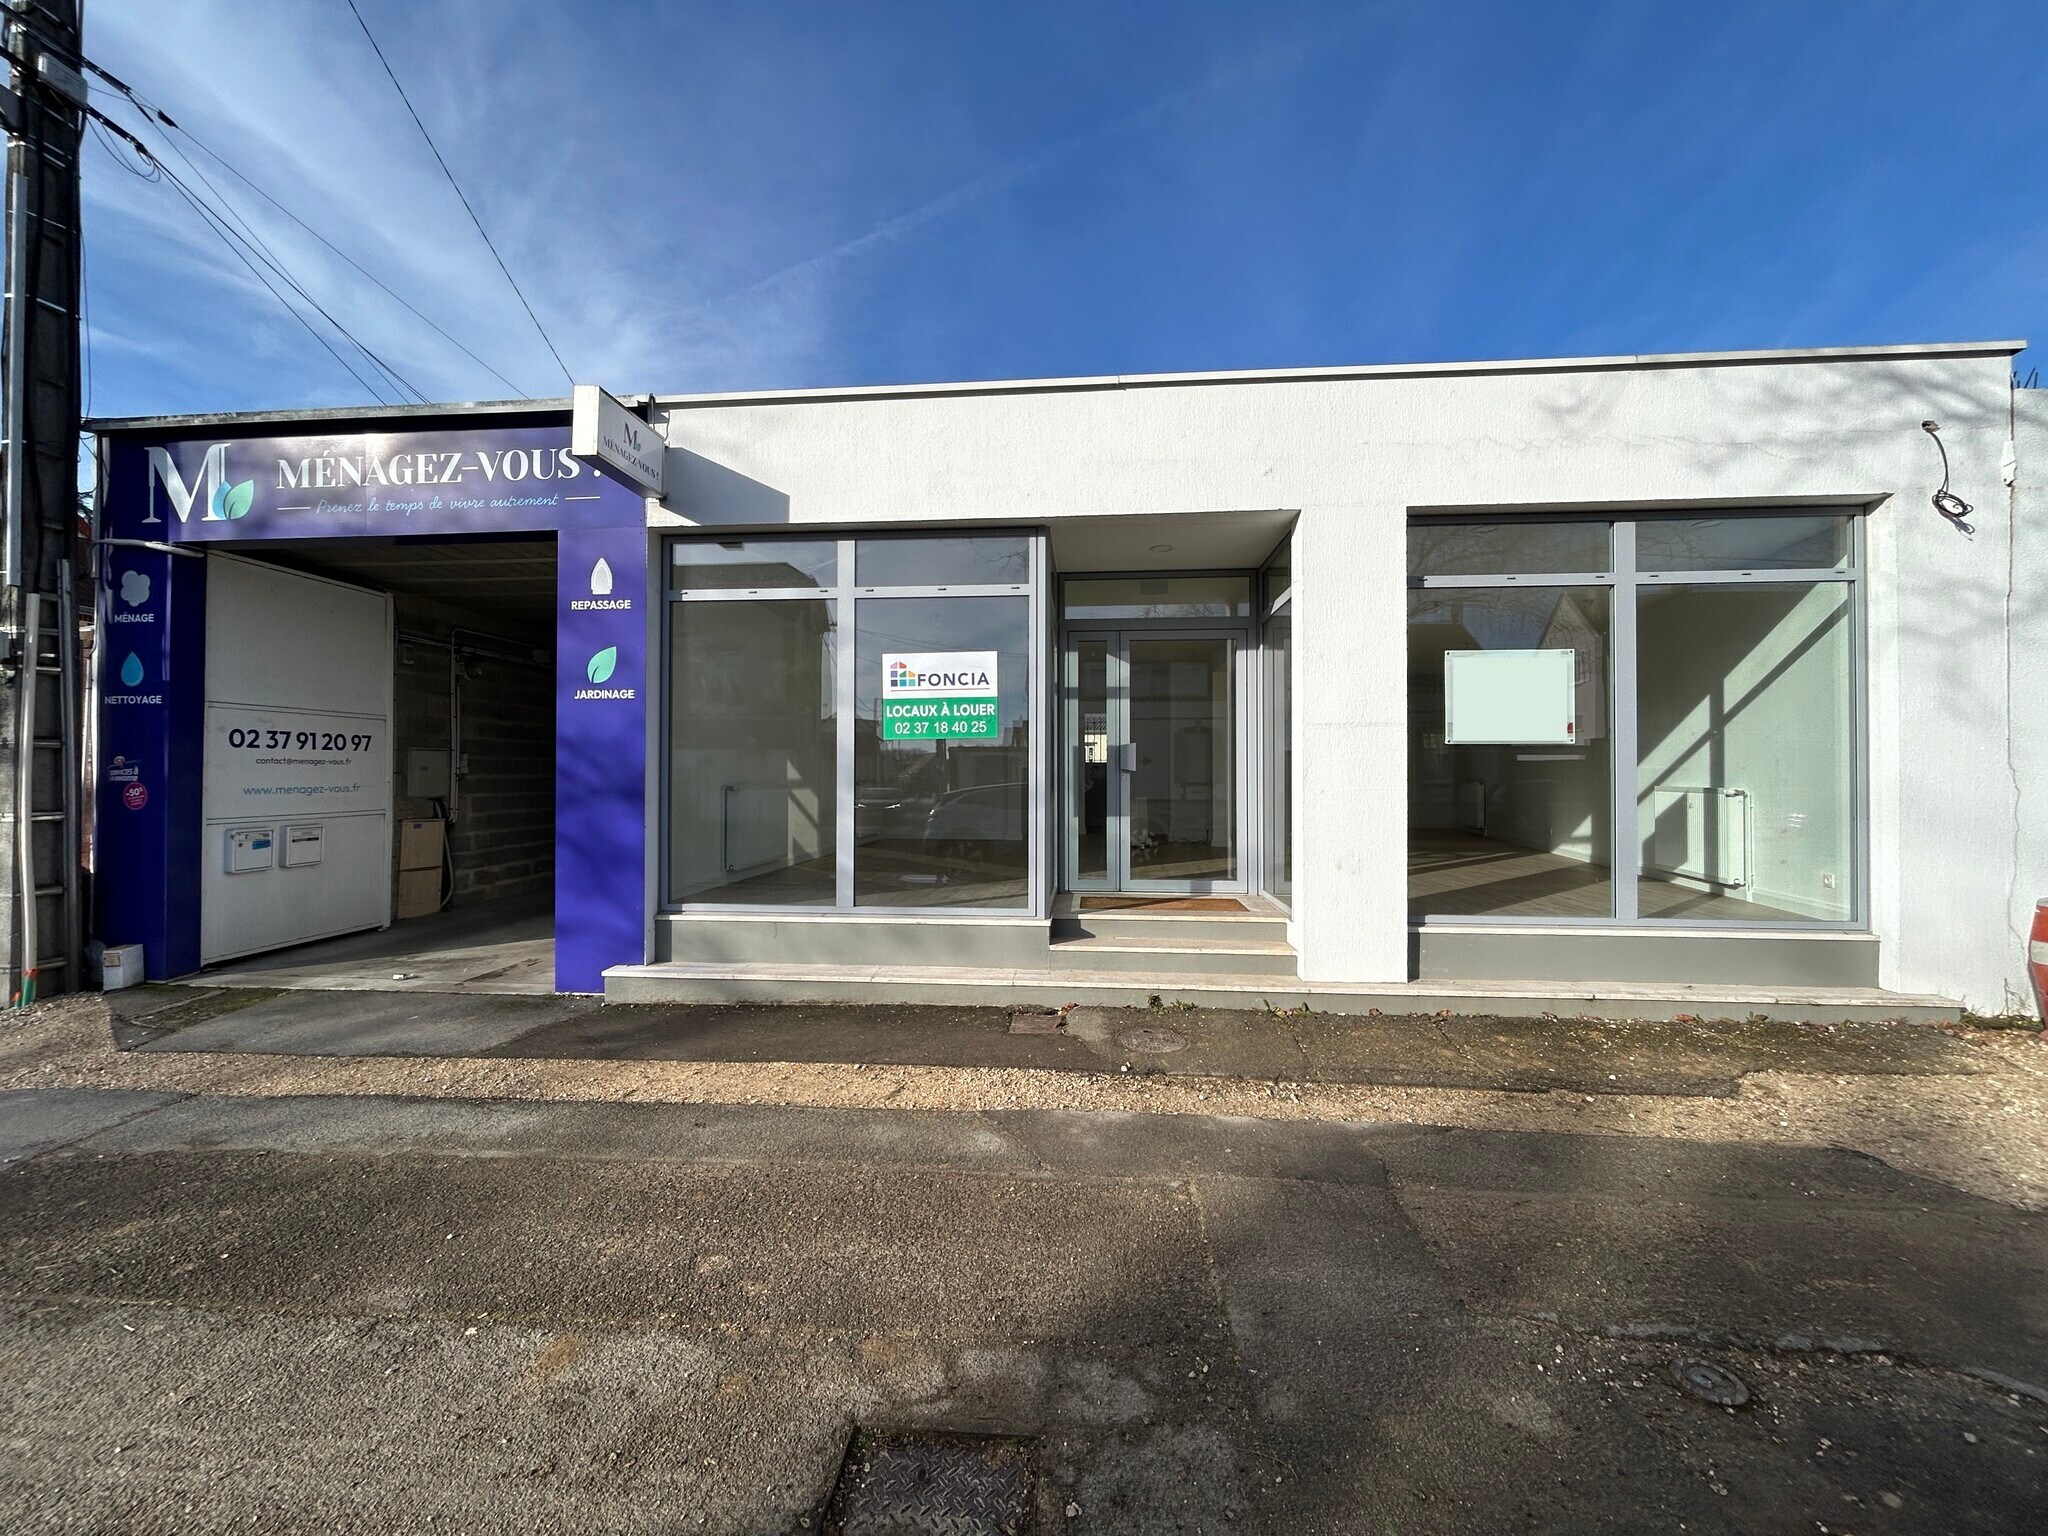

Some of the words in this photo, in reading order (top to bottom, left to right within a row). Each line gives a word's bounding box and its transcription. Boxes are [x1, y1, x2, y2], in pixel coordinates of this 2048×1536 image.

[276, 447, 580, 489] MÉNAGEZ-VOUS
[316, 500, 363, 514] Prenez
[368, 497, 379, 512] le
[385, 500, 424, 516] temps
[429, 496, 442, 511] de
[449, 498, 485, 509] vivre
[490, 493, 559, 508] autrement
[571, 600, 632, 610] REPASSAGE
[917, 672, 990, 687] FONCIA
[104, 695, 163, 704] NETTOYAGE
[574, 689, 635, 699] JARDINAGE
[886, 704, 938, 718] LOCAUX
[941, 701, 950, 717] À
[953, 704, 995, 716] LOUER
[894, 722, 911, 735] 02
[913, 722, 930, 734] 37
[933, 722, 949, 734] 18
[951, 721, 968, 734] 40
[970, 720, 987, 733] 25
[228, 728, 260, 749] 02
[265, 730, 292, 750] 37
[296, 732, 317, 750] 91
[321, 733, 347, 751] 20
[351, 734, 372, 752] 97
[255, 757, 352, 767] contact@menagez-vous.fr
[243, 783, 361, 797] www.menagez-vous.fr
